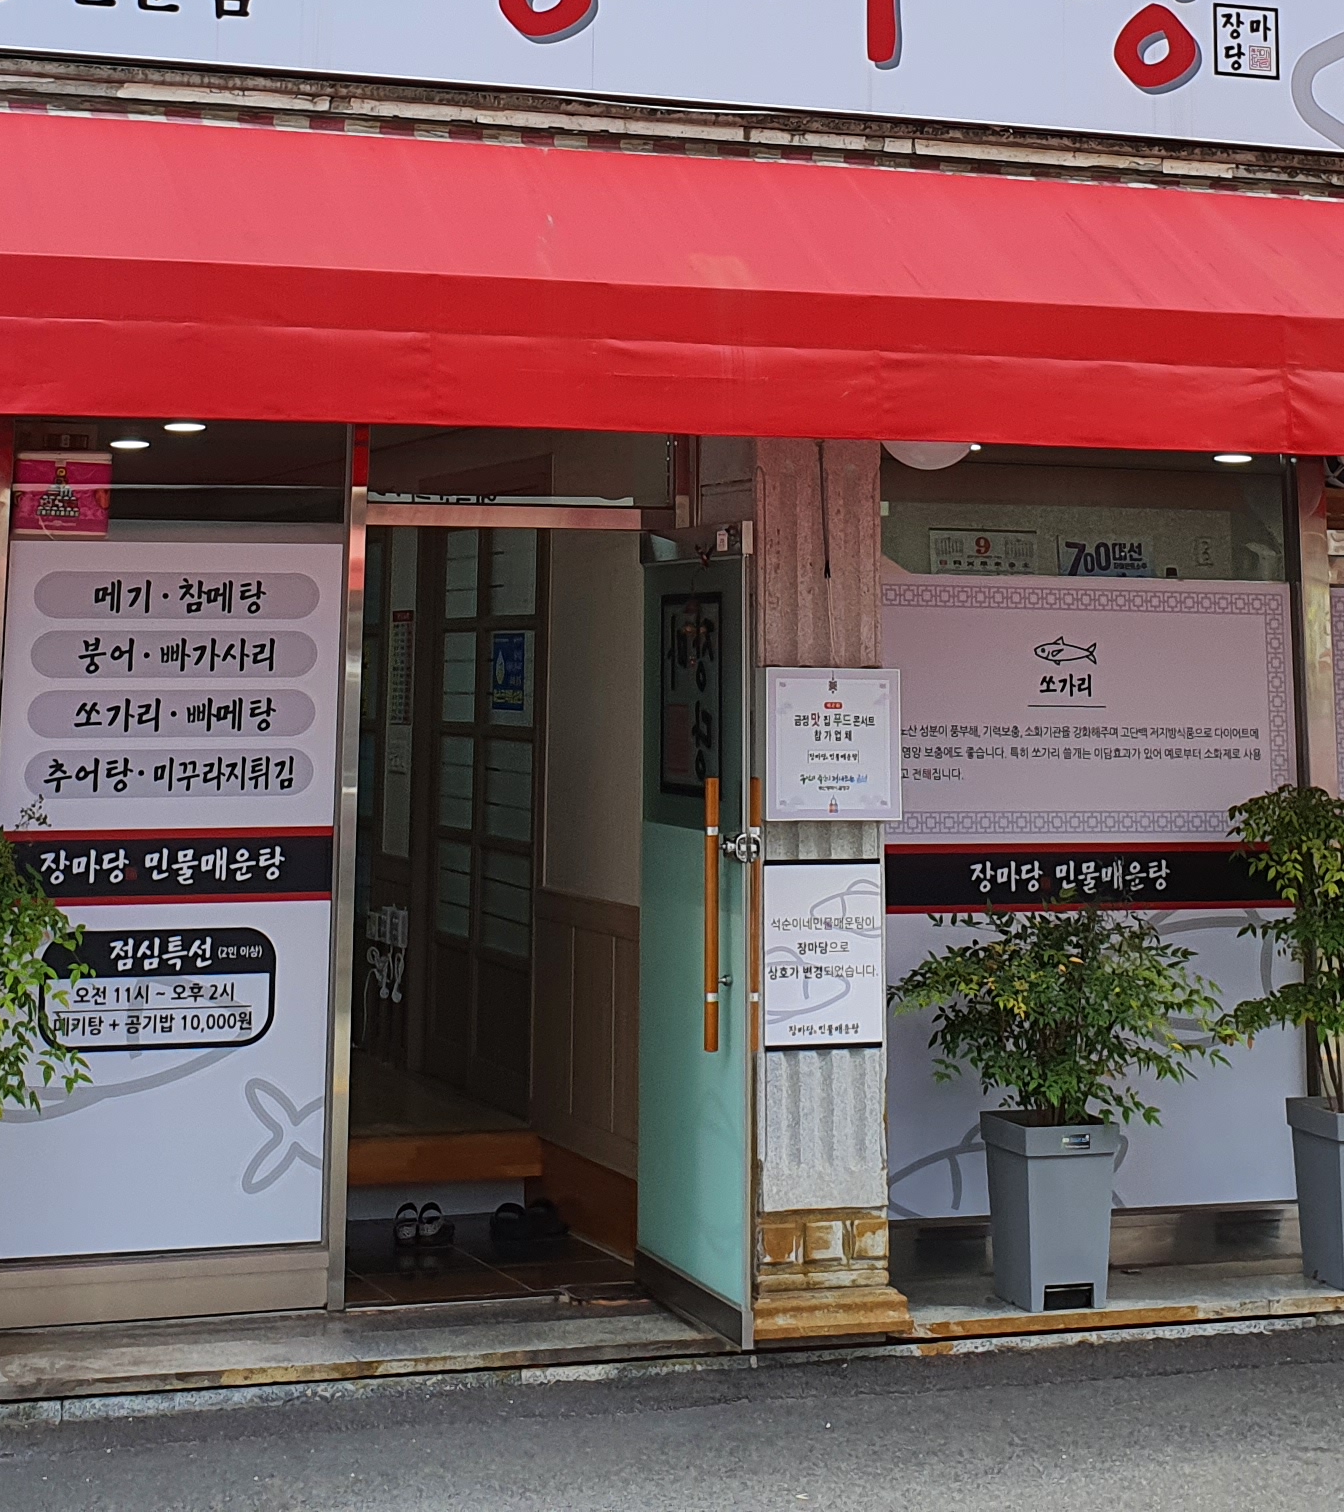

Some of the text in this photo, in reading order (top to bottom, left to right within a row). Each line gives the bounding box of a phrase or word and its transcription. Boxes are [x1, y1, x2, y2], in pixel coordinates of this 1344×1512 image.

[975, 536, 991, 555] 9
[1039, 674, 1093, 698] 쏘가리
[1010, 747, 1029, 760] 특히
[1031, 747, 1060, 760] 쏘가리
[39, 846, 286, 885] 장마당 민물매운탕
[969, 859, 1171, 894] 장마당 민물매운탕
[109, 935, 212, 971] 점심특선
[74, 986, 106, 1005] 오전
[114, 984, 150, 1004] 11시
[171, 982, 204, 1002] 오후
[210, 982, 235, 1002] 2시
[125, 1014, 175, 1035] 공기밥
[181, 1010, 253, 1033] 10,000원
